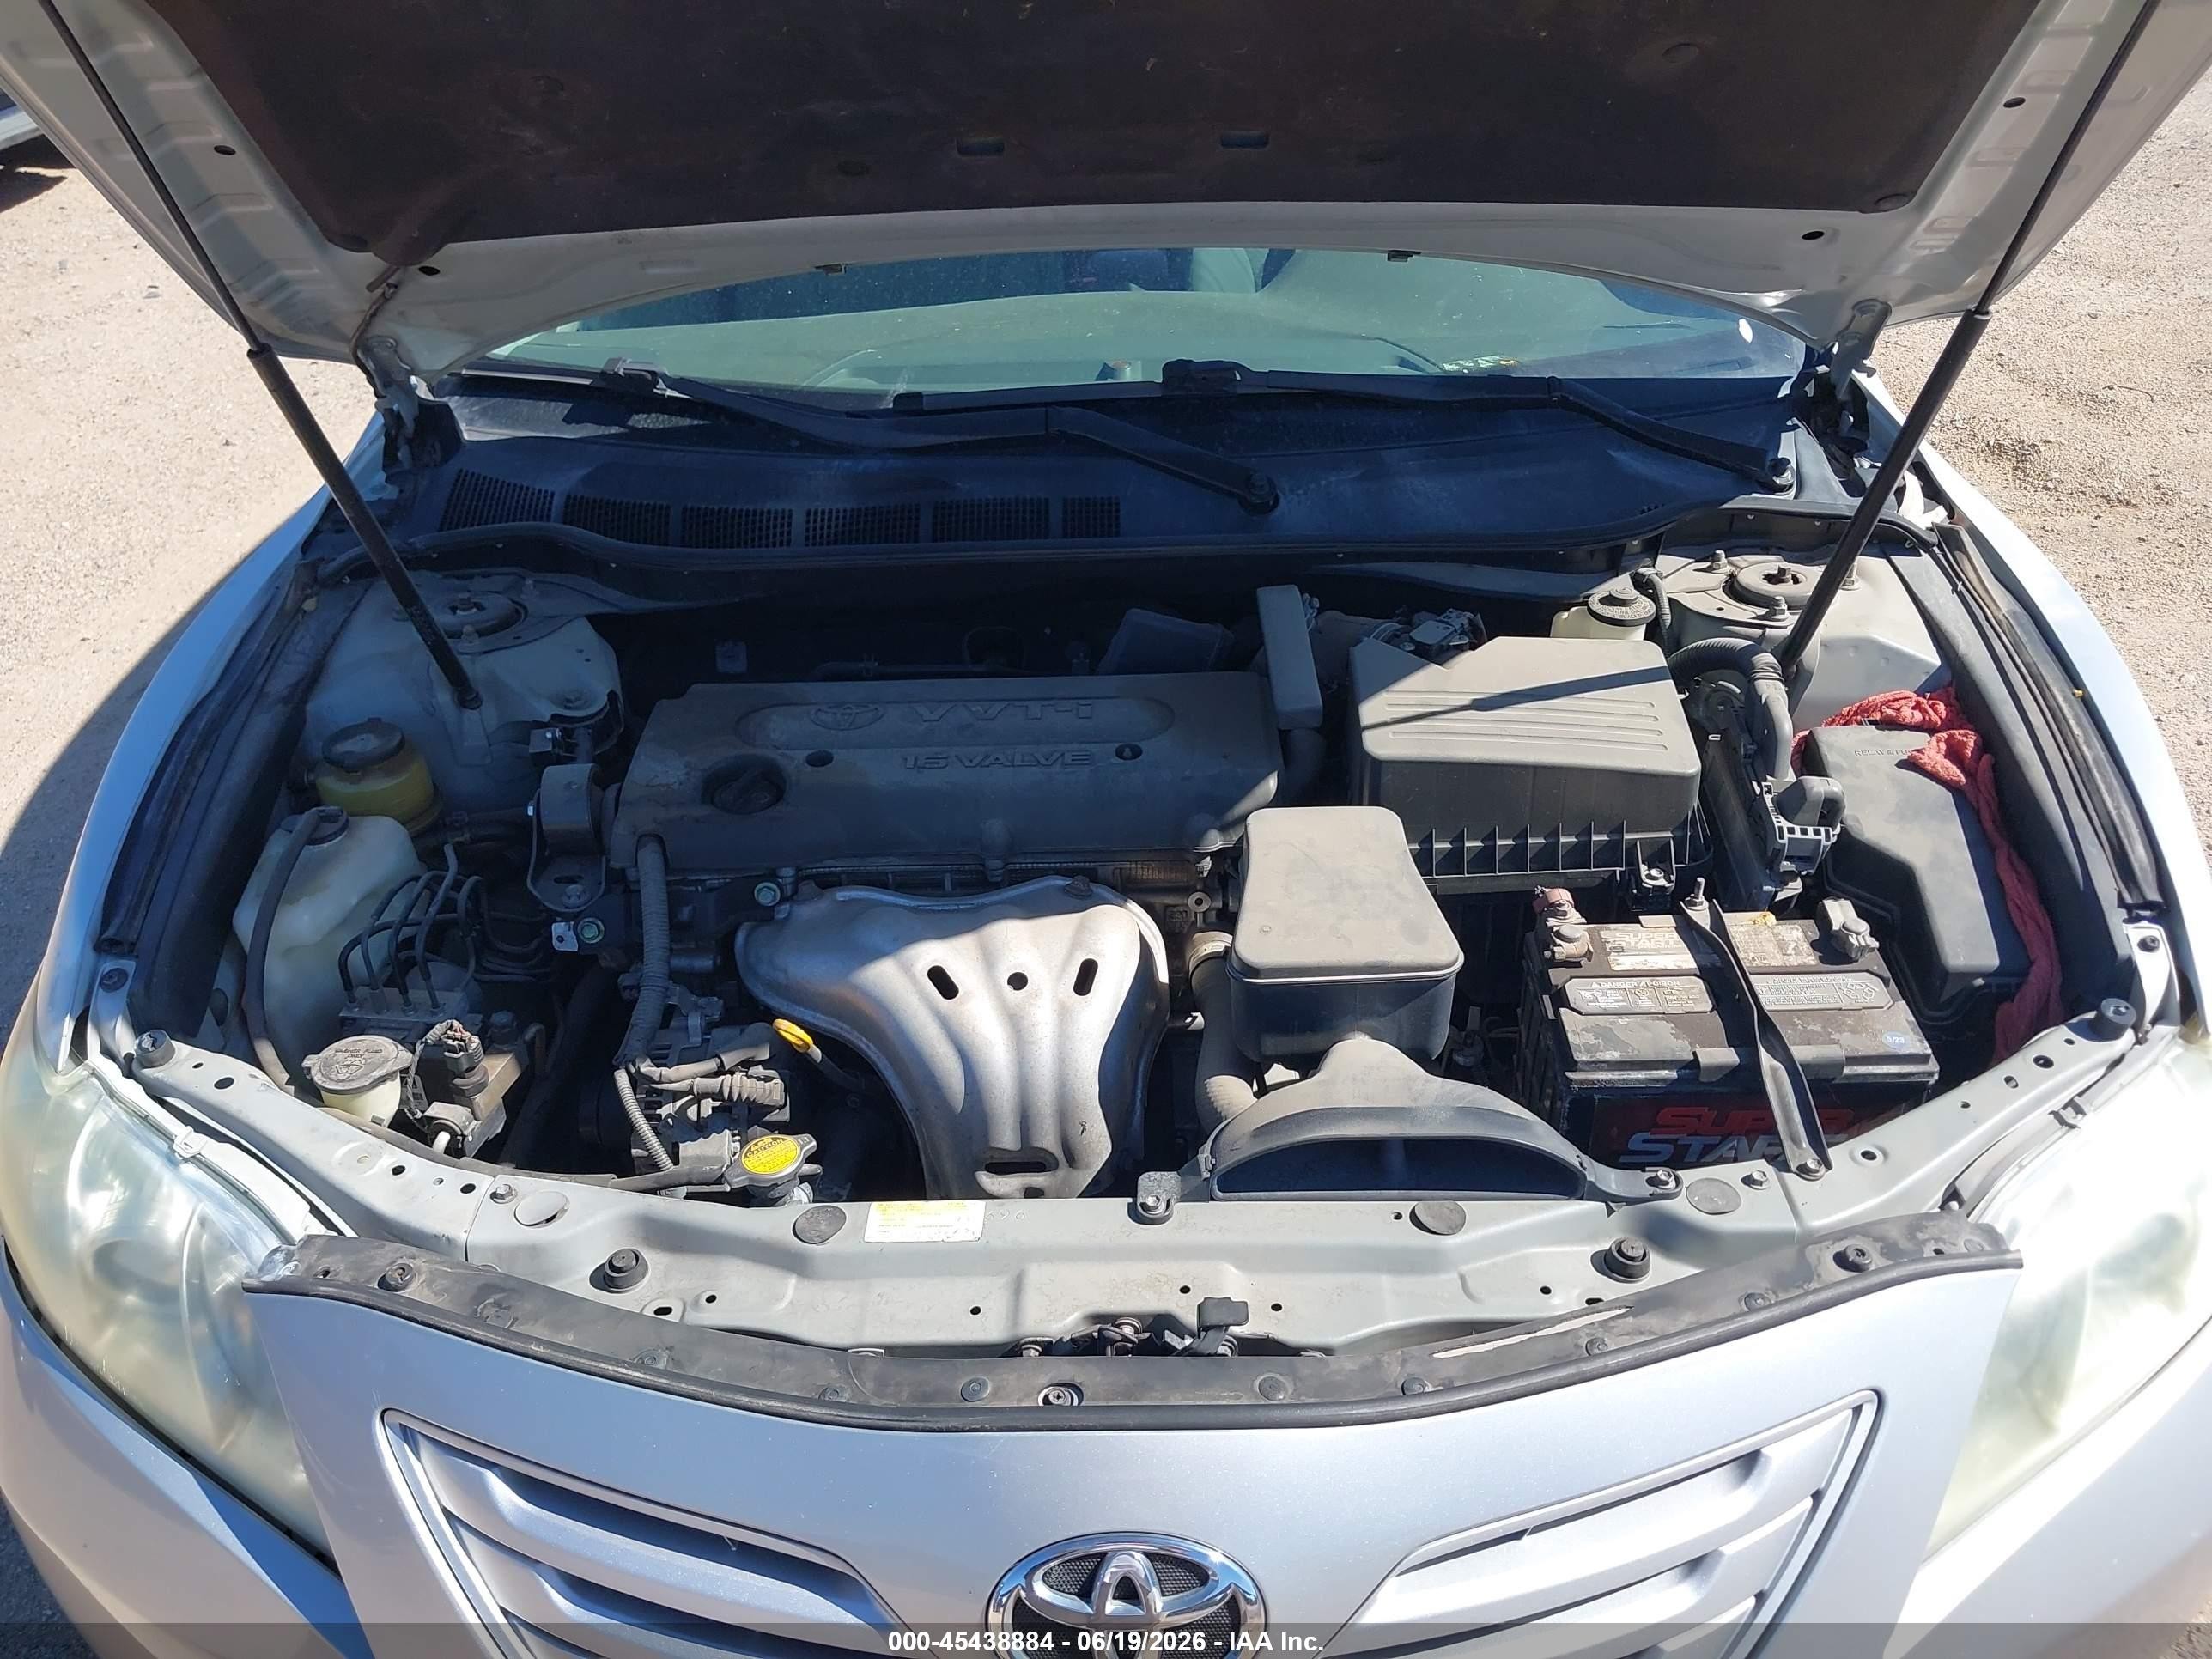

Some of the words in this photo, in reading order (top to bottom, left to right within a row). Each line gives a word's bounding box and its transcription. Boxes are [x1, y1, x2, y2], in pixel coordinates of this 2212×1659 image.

[955, 750, 1092, 769] VALVE
[1615, 932, 1679, 940] SUPER
[1650, 1106, 1855, 1135] SUPR
[746, 1139, 783, 1157] CAUTION
